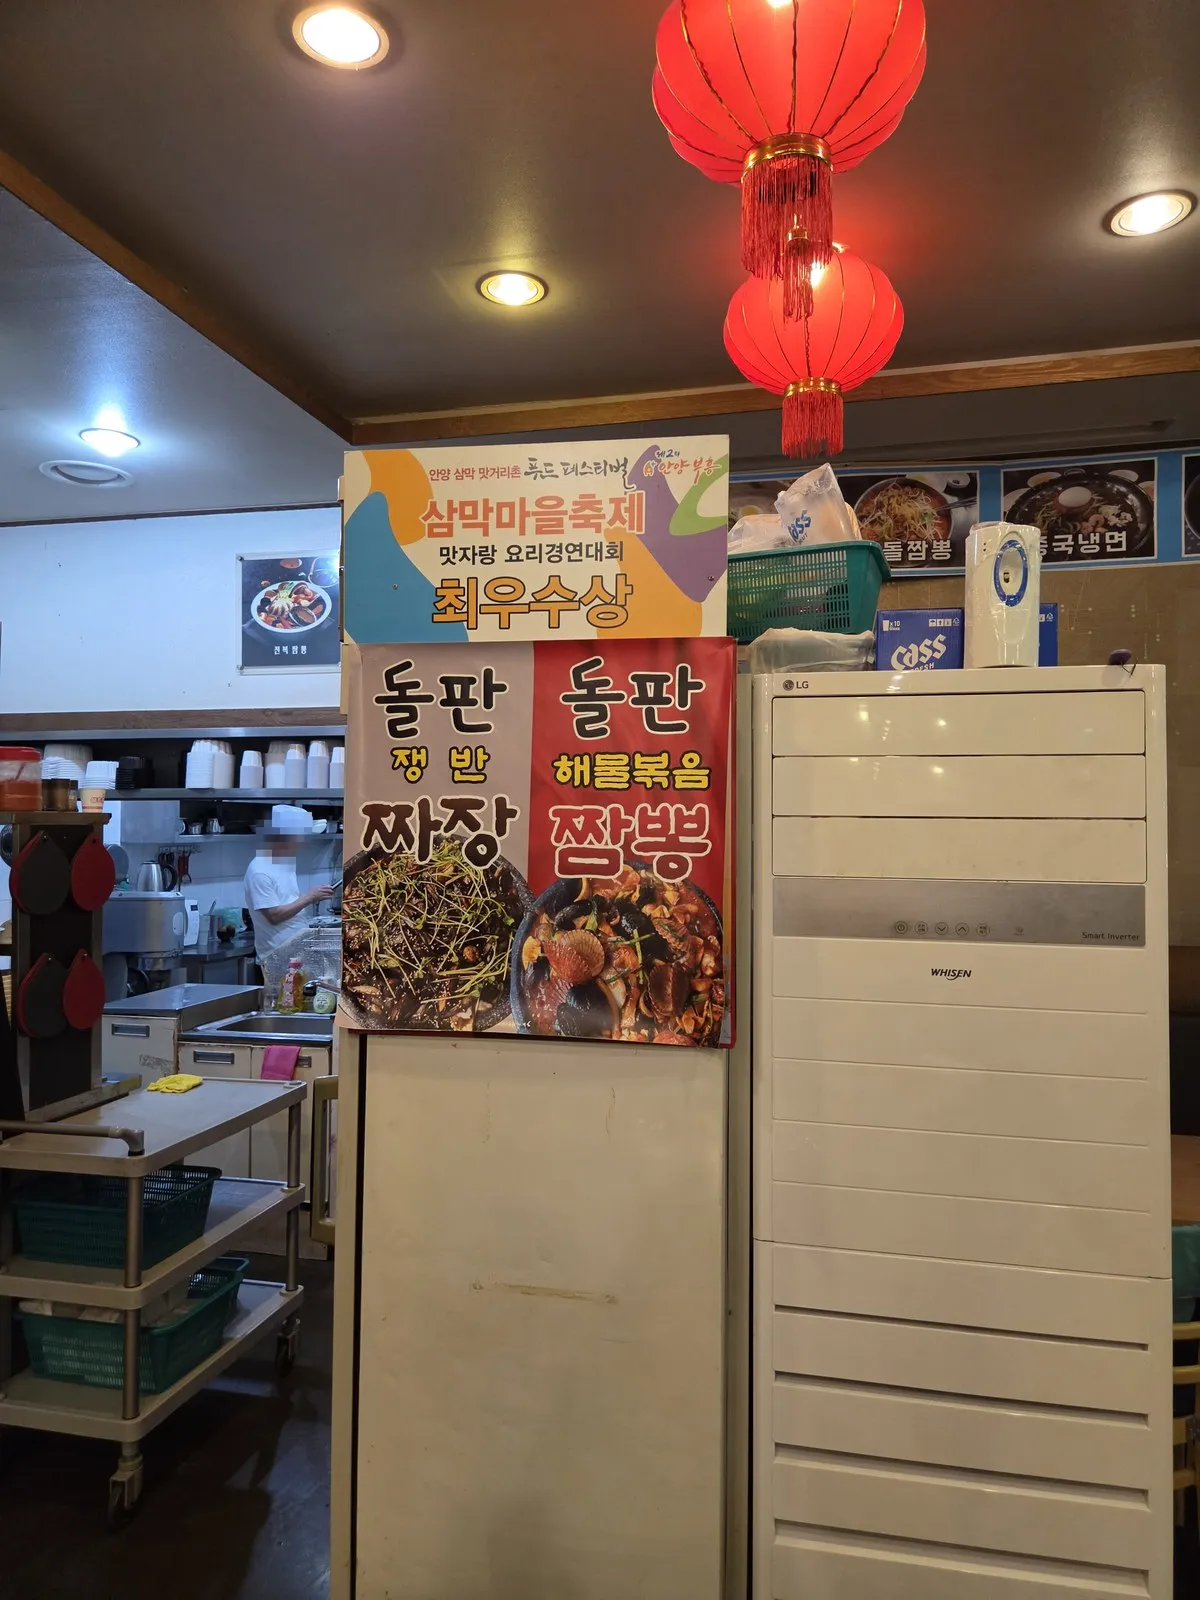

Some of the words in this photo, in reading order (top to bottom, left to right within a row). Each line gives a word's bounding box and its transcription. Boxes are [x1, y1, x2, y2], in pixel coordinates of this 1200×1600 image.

[429, 467, 451, 481] 안양
[453, 466, 475, 480] 삼막
[478, 465, 521, 480] 맛거리촌
[523, 457, 559, 481] 푸드
[560, 456, 636, 490] 페스티벌
[659, 459, 690, 475] 안양
[693, 457, 722, 485] 부흥
[420, 490, 647, 538] 삼막마을축제
[439, 544, 498, 566] 맛자랑
[504, 541, 625, 564] 요리경연대회
[431, 572, 633, 630] 최우수상
[891, 634, 946, 671] Cass
[796, 680, 809, 689] LG
[552, 751, 712, 790] 해물볶음
[359, 793, 520, 869] 짜장
[549, 802, 712, 882] 짬뽕
[1082, 931, 1105, 940] Smart
[1107, 932, 1140, 942] Inverter
[931, 968, 972, 981] WHISEN
